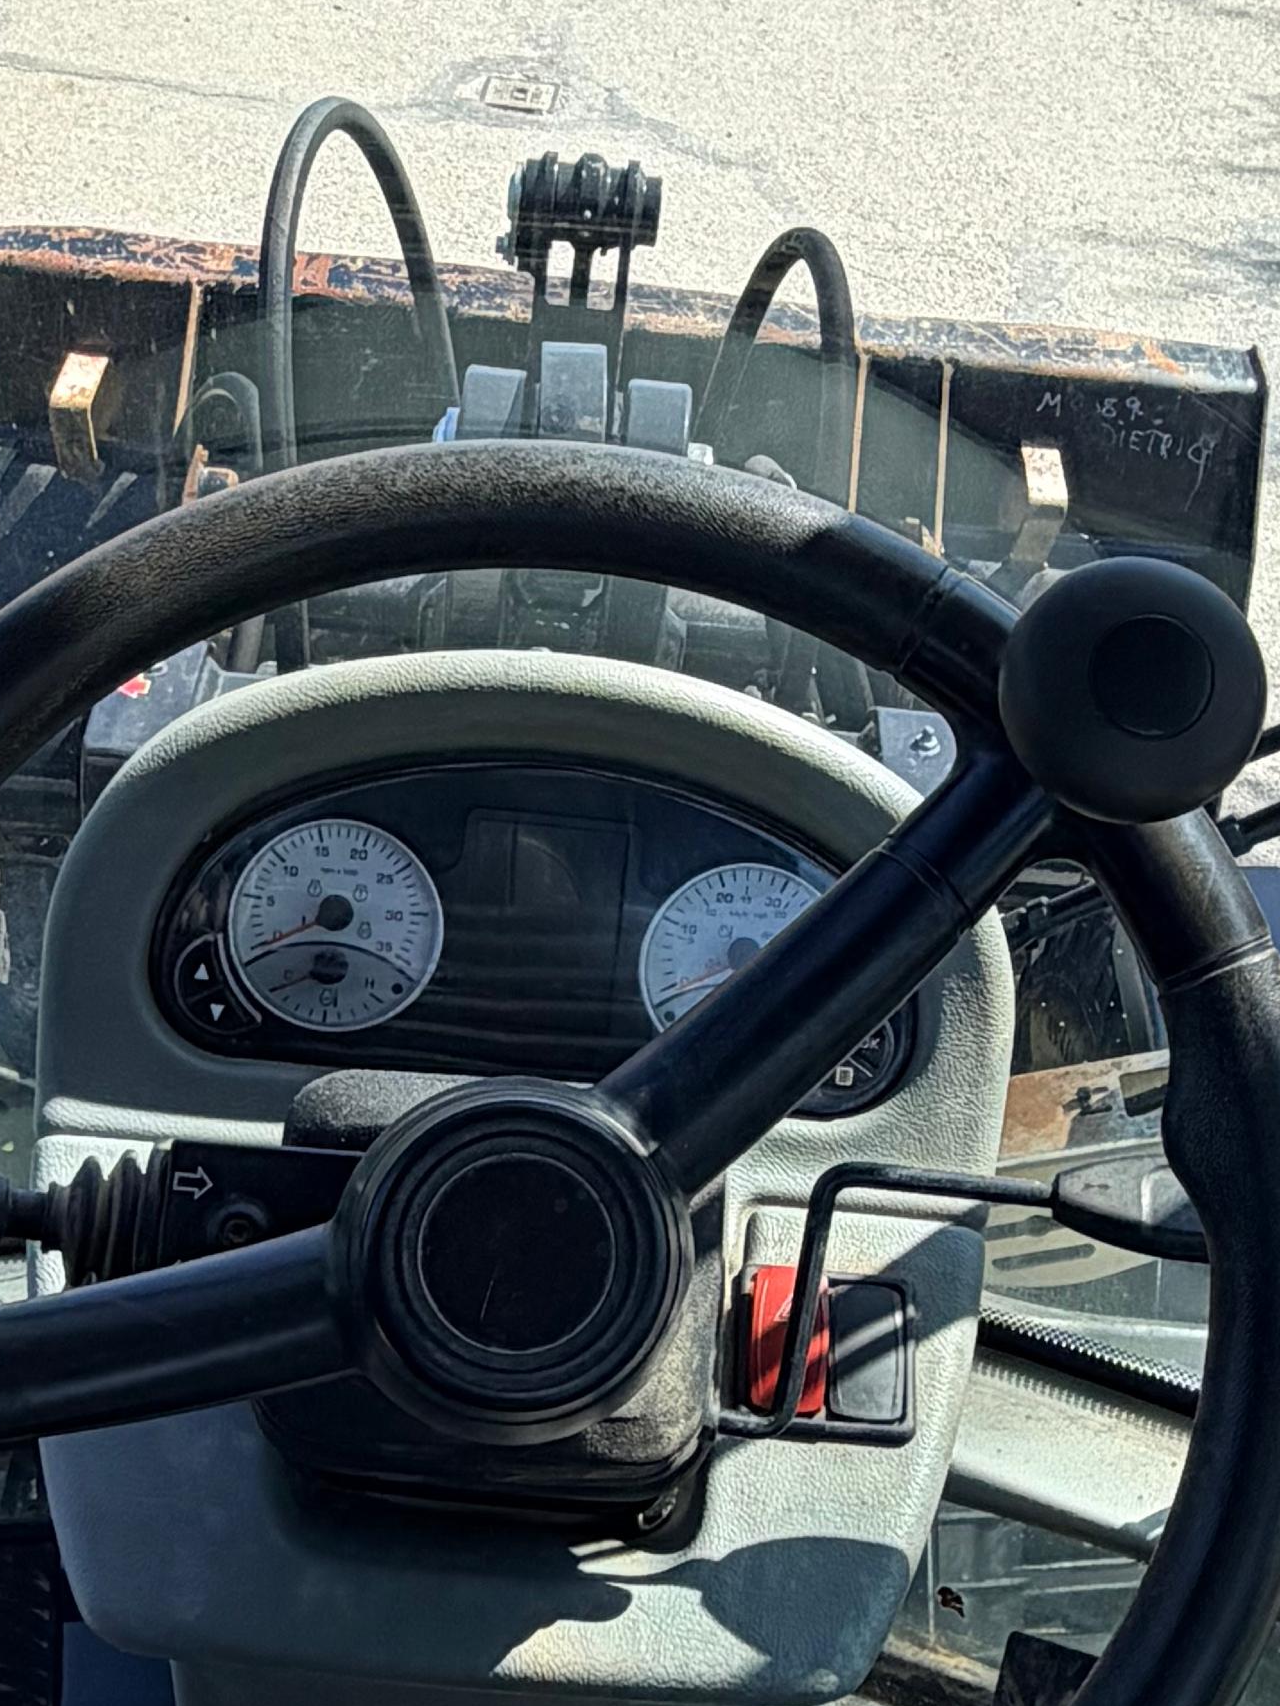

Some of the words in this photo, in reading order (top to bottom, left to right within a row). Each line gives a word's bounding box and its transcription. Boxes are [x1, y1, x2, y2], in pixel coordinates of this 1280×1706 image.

[314, 845, 330, 858] 15
[349, 848, 369, 861] 20
[283, 865, 299, 878] 10
[376, 872, 394, 885] 25
[266, 895, 276, 907] 5
[716, 892, 734, 904] 20
[764, 896, 782, 908] 30
[384, 909, 404, 922] 30
[681, 924, 698, 935] 10
[375, 941, 393, 953] 35
[365, 978, 376, 990] H
